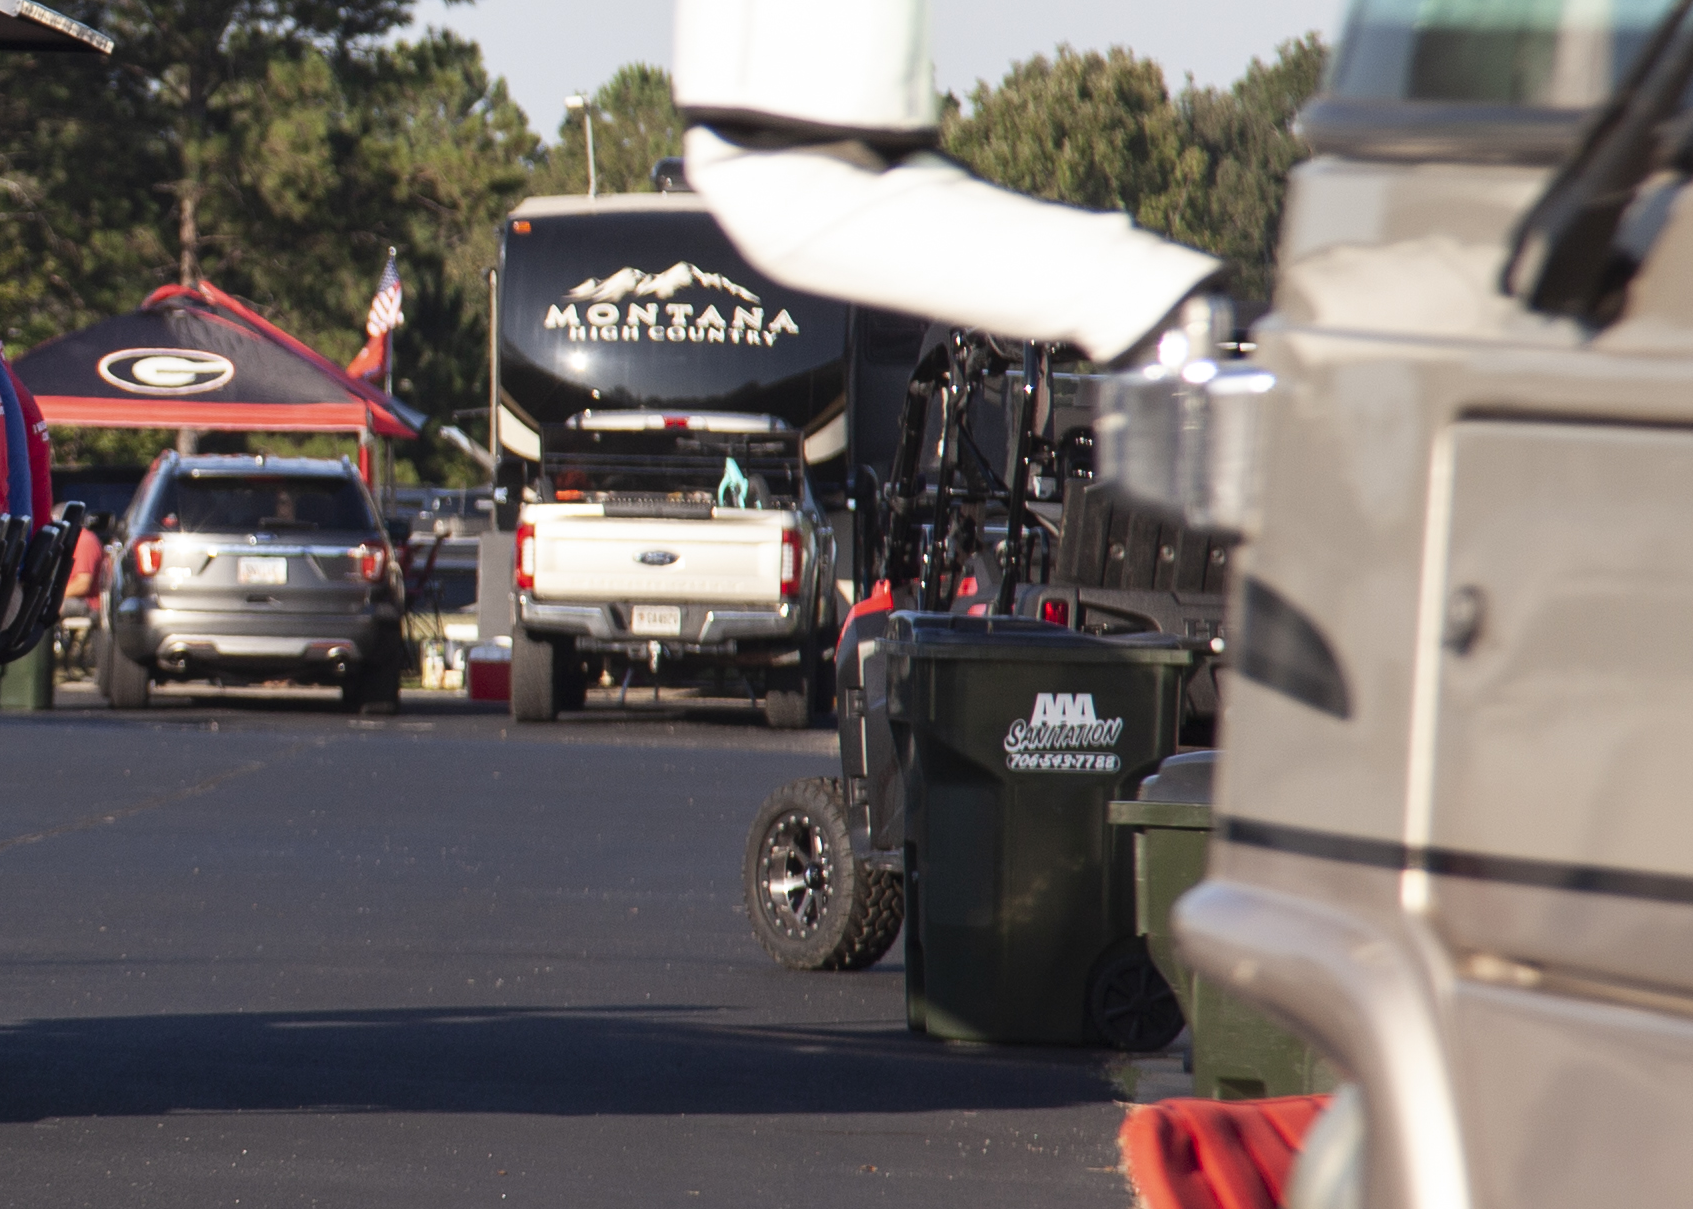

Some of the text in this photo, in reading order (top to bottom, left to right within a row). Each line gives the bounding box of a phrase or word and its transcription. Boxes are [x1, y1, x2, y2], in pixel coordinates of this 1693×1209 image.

[544, 302, 799, 334] MONTANA
[569, 325, 777, 347] HIGH COUNTRY
[125, 354, 231, 388] G
[1029, 692, 1097, 726] AAA
